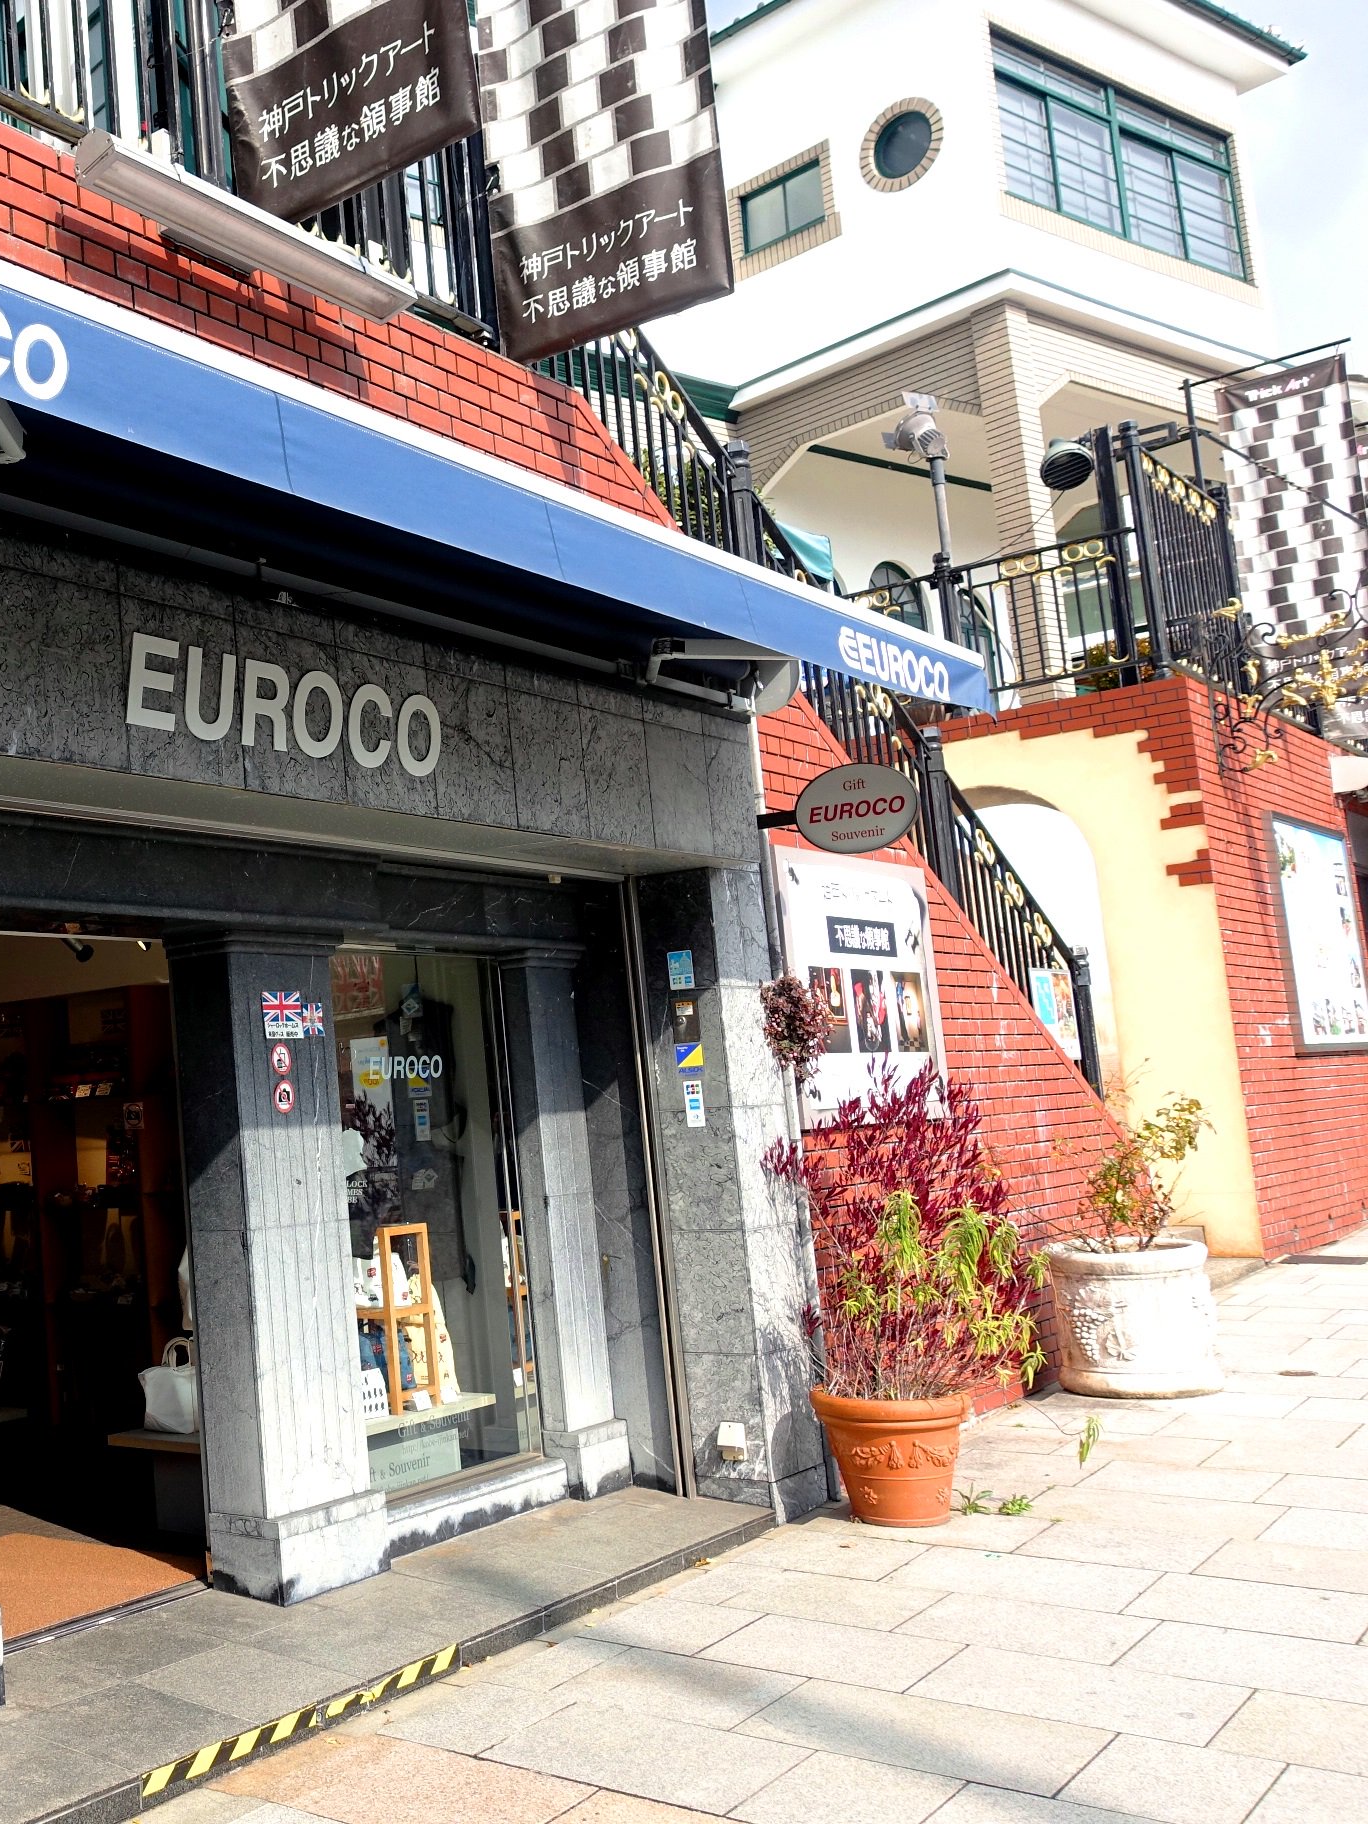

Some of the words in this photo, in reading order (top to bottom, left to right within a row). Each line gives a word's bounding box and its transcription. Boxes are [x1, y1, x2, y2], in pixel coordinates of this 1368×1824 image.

[258, 20, 436, 142] 神戸トリックアート
[261, 66, 441, 189] 不思議な領事館
[519, 198, 694, 285] 神戸トリックアート
[522, 238, 697, 324] 不思議な領事館
[127, 632, 442, 777] EUROCO
[843, 778, 866, 792] Gift
[809, 795, 906, 824] EUROCO
[831, 825, 886, 842] Souvenir
[369, 1055, 443, 1080] EUROCO
[397, 1419, 417, 1438] Gift
[429, 1410, 471, 1430] Souvenir
[388, 1453, 431, 1477] Souvenir
